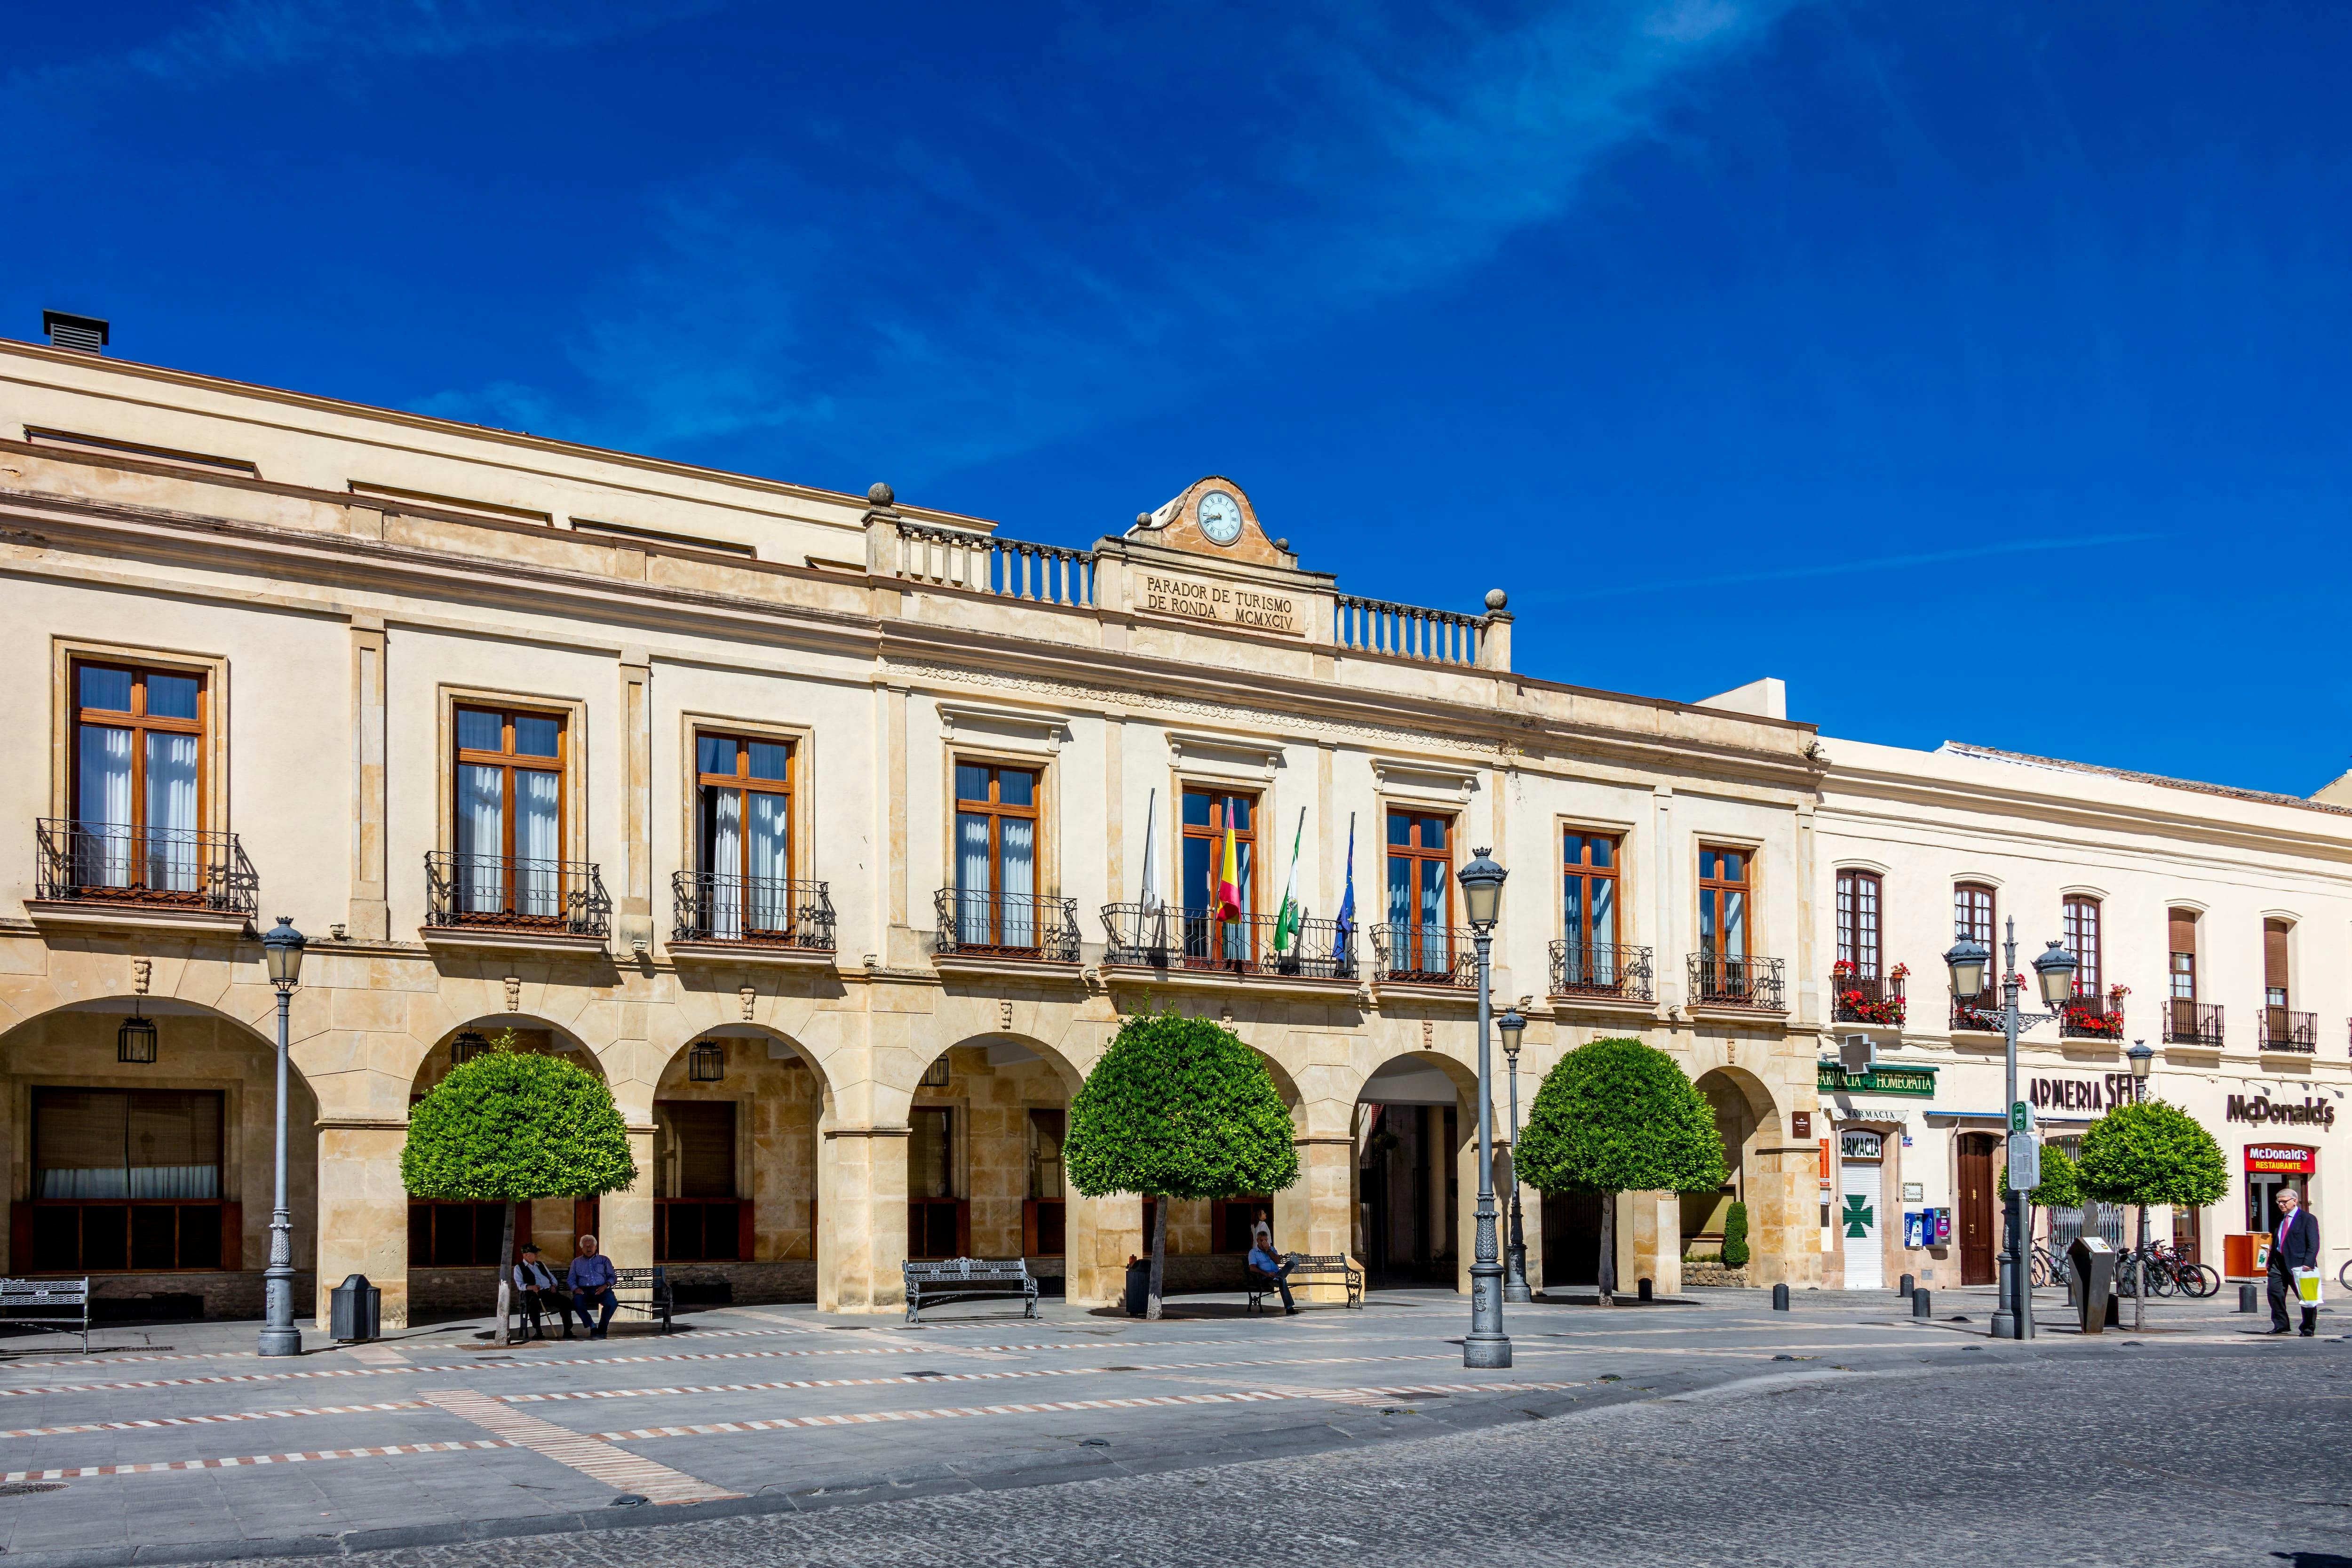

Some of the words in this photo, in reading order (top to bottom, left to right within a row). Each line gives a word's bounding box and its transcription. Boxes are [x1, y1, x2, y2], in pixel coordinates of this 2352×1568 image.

[1147, 577, 1208, 600] PARADOR
[1212, 588, 1231, 603] DE
[1235, 592, 1292, 613] TURISMO
[1148, 594, 1167, 610] DE
[1171, 598, 1216, 619] RONDA
[1235, 608, 1293, 629] MCMXCIV
[1817, 1071, 1861, 1087] FARMACIA
[1875, 1073, 1932, 1090] HOMEOPATIA
[2030, 1078, 2102, 1109] ARMERIA
[2105, 1074, 2138, 1115] SA
[1847, 1109, 1896, 1119] FARMACIA
[2226, 1094, 2335, 1124] McDonald's
[1841, 1137, 1880, 1156] ARMACIA
[2249, 1148, 2308, 1161] McDonald's
[2256, 1161, 2301, 1170] RESTAURANTE
